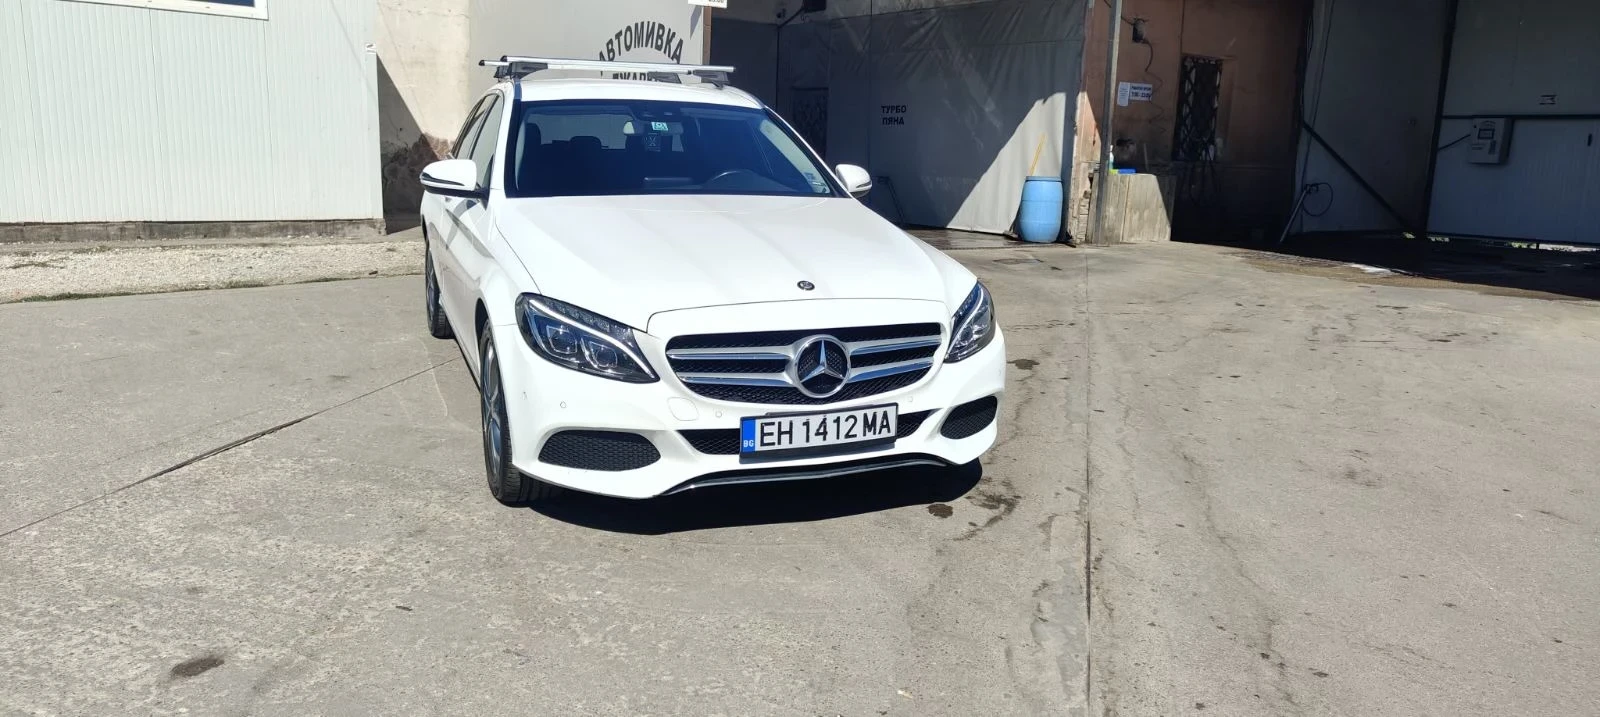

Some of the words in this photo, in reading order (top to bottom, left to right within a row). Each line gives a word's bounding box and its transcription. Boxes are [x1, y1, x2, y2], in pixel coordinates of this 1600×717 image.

[599, 21, 684, 66] АВТОМИВКА
[881, 104, 907, 114] ТУРБО
[882, 116, 905, 126] ПЯНА
[760, 420, 793, 447] EH
[802, 415, 858, 443] 1412
[862, 410, 891, 437] MA
[743, 439, 754, 448] BG
